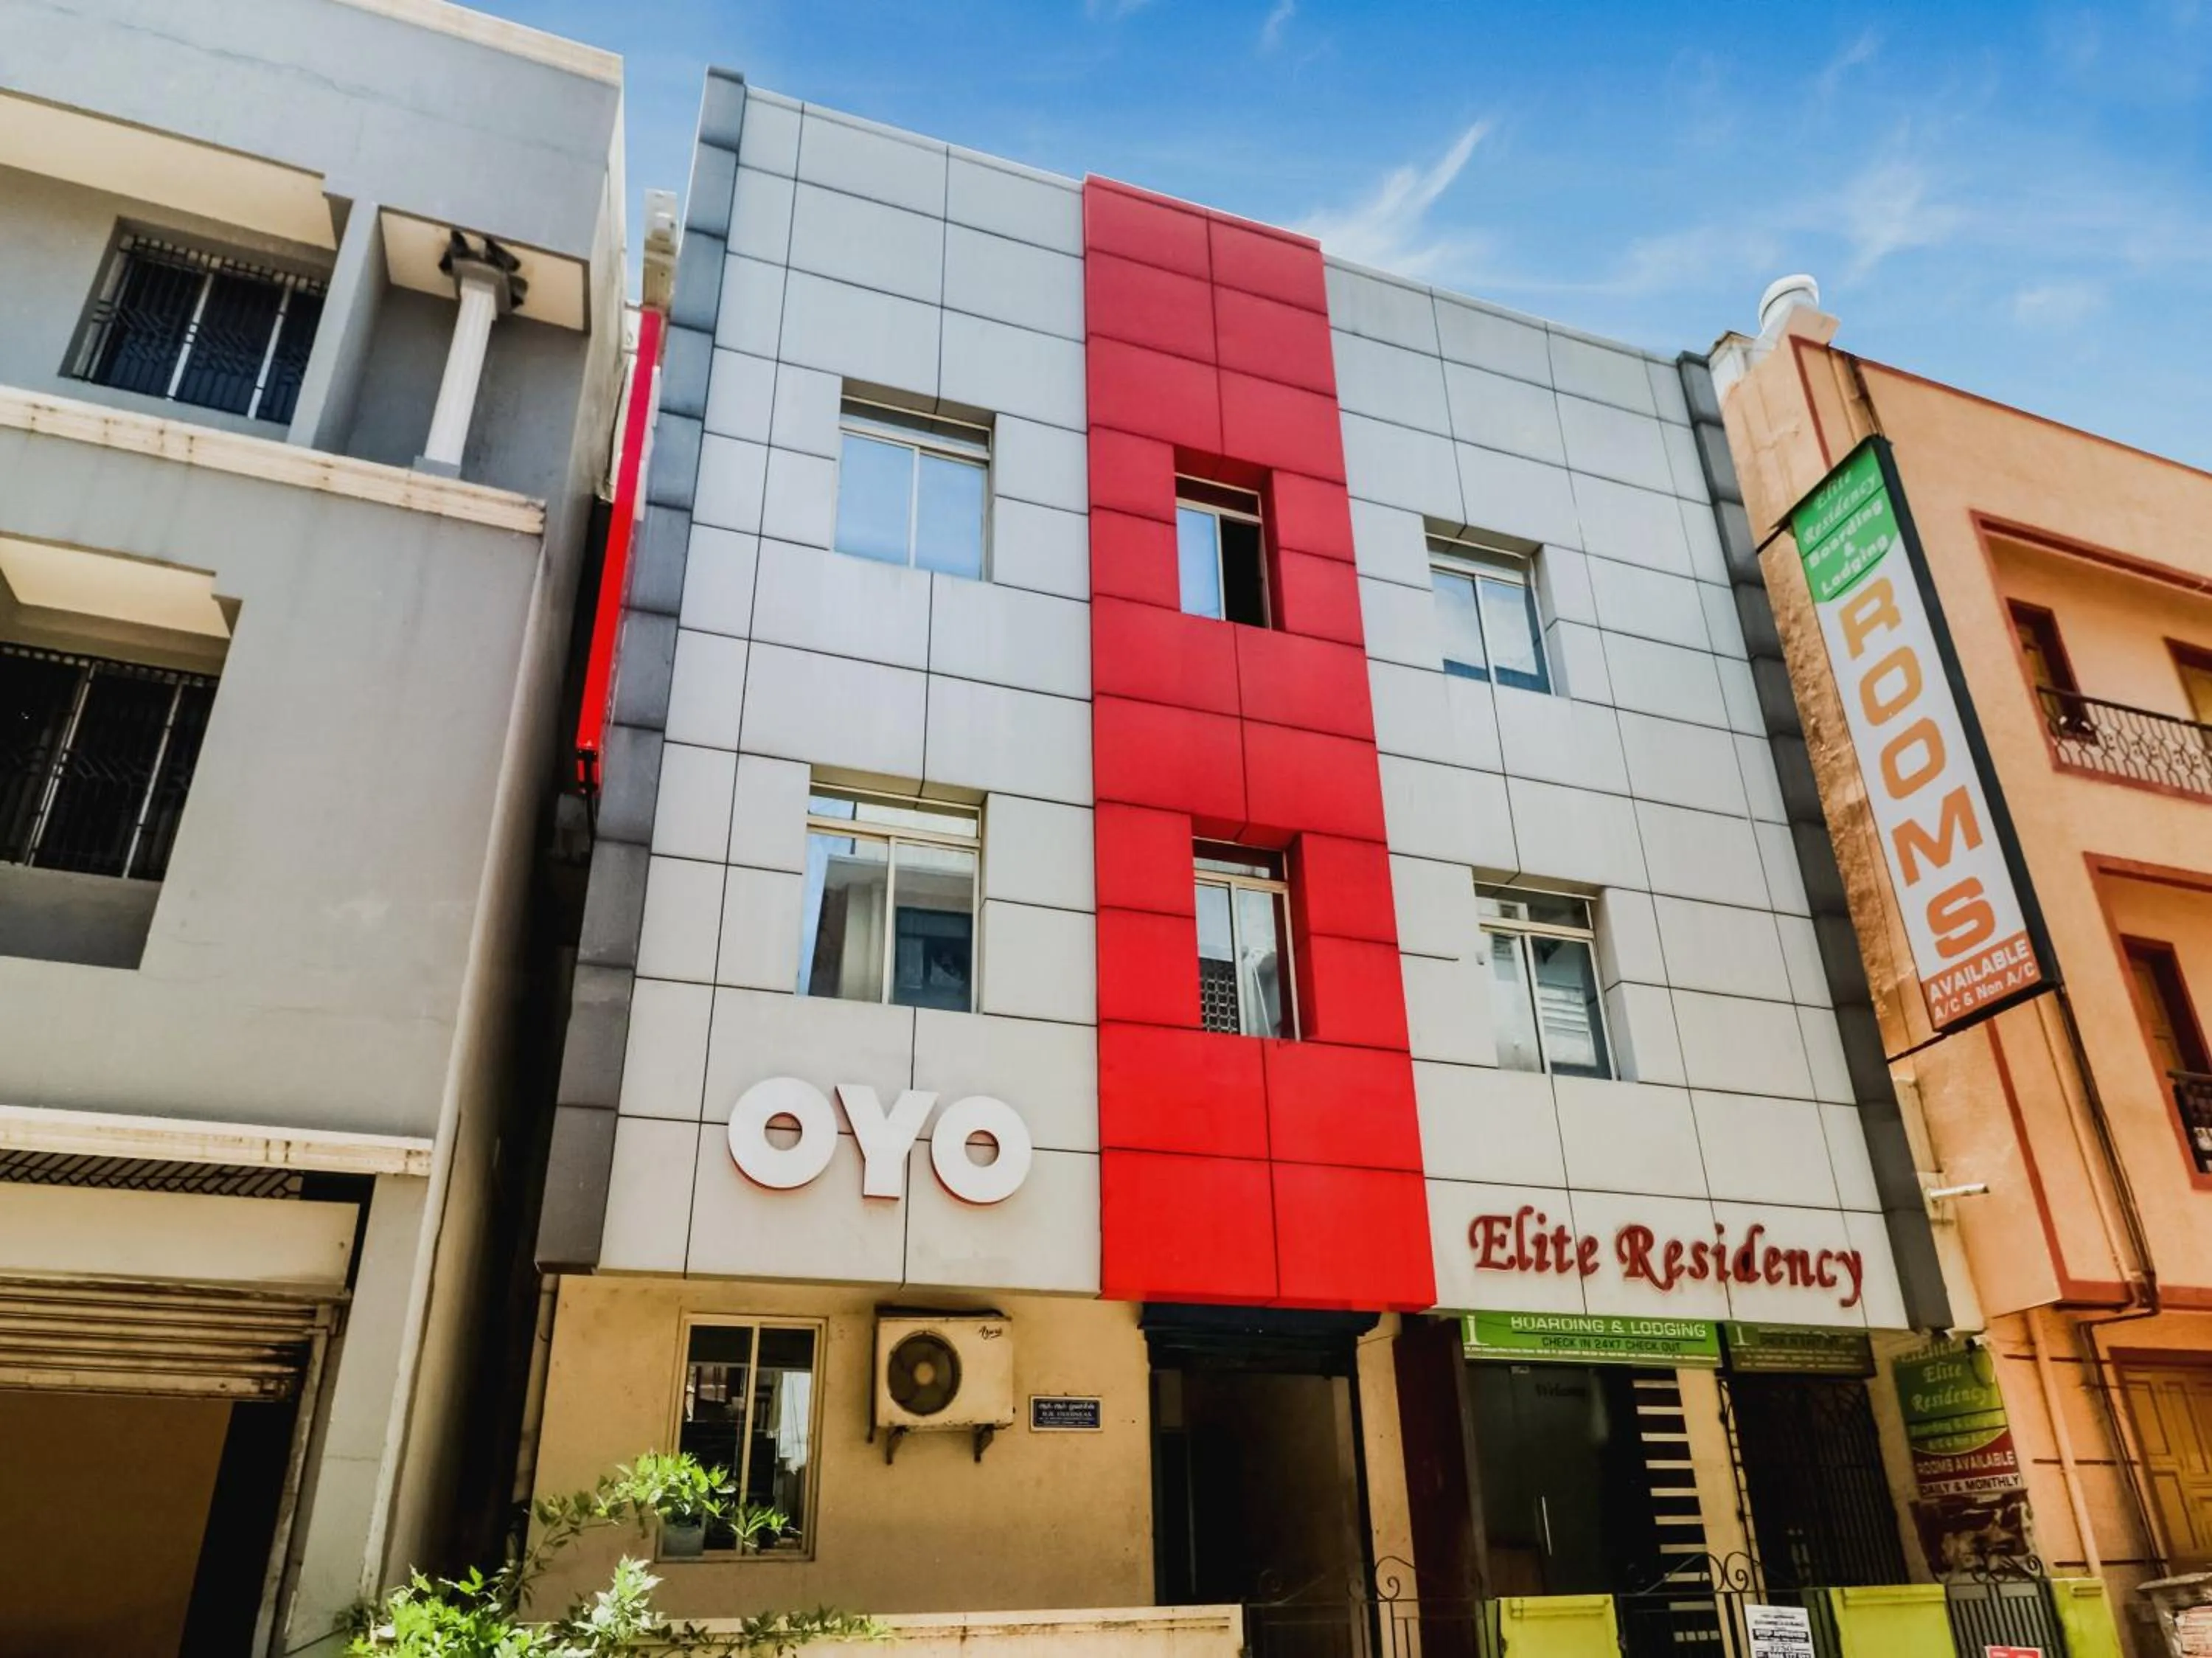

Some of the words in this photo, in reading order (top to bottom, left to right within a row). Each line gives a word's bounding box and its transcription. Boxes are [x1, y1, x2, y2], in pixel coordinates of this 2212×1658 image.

[1804, 473, 1876, 544] Residency
[1809, 499, 1883, 569] Boarding
[1821, 534, 1888, 596] Lodging
[1844, 541, 1856, 558] &
[1839, 577, 1995, 959] ROOMS
[1930, 939, 2029, 1004] AVAILABLE
[1935, 997, 1960, 1021] A/C
[1964, 992, 1974, 1006] &
[1975, 980, 2003, 1000] Non
[2006, 962, 2035, 986] A/C
[728, 1076, 1032, 1204] OYO
[1469, 1204, 1600, 1277] Elite
[1615, 1222, 1863, 1307] Residency
[1512, 1317, 1604, 1333] BOARDING
[1611, 1321, 1624, 1333] &
[1631, 1322, 1706, 1337] LODGING
[1542, 1336, 1576, 1348] CHECK
[1580, 1339, 1591, 1349] IN
[1595, 1339, 1621, 1350] 24X7
[1625, 1340, 1658, 1351] CHECK
[1661, 1342, 1681, 1353] OUT
[1911, 1385, 1986, 1412] Residency
[1923, 1362, 1962, 1382] Elite
[1956, 1450, 2016, 1472] AVAILABLE
[1965, 1474, 2019, 1491] MONTHLY
